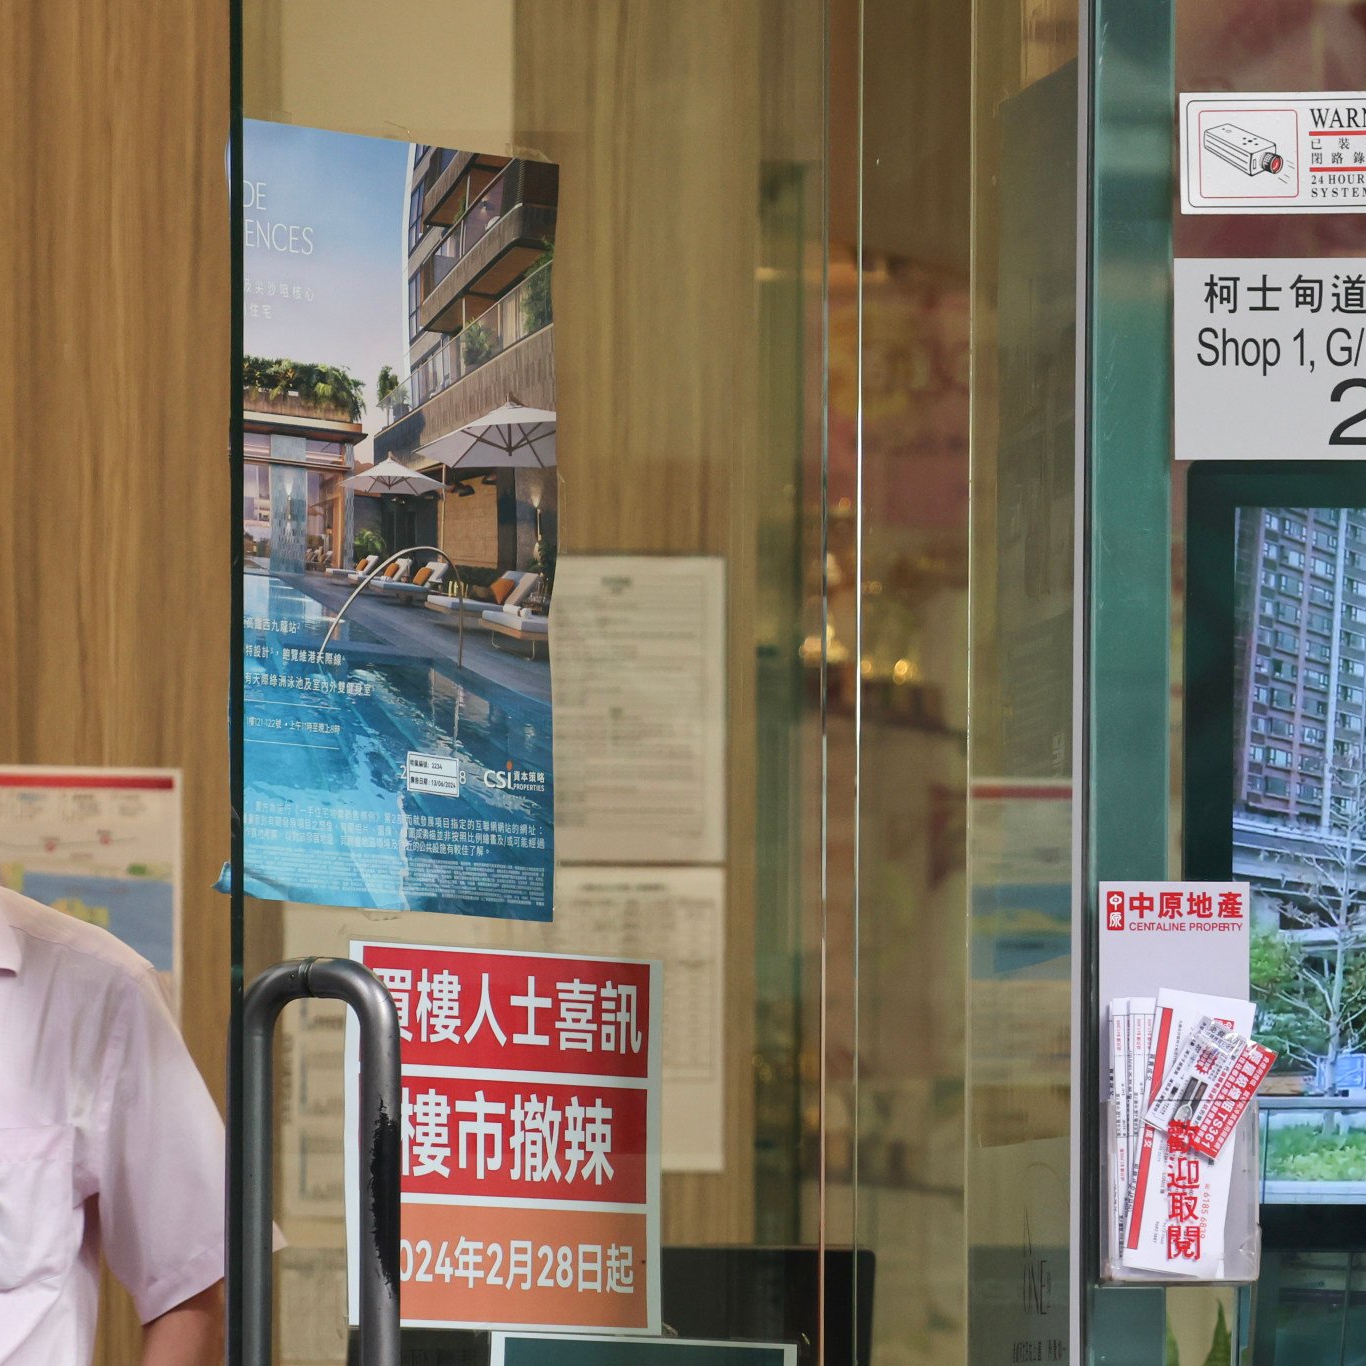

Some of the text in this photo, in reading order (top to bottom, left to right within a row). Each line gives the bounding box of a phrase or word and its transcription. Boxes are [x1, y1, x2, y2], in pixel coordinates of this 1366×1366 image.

[1311, 174, 1325, 185] 24
[1328, 173, 1365, 185] HOUR
[1196, 326, 1281, 376] Shop
[1292, 327, 1316, 374] 1,
[1129, 891, 1244, 920] 中原地產
[1129, 922, 1244, 932] CENTALINE PROPERTY
[400, 1235, 635, 1294] 024年2月28日起
